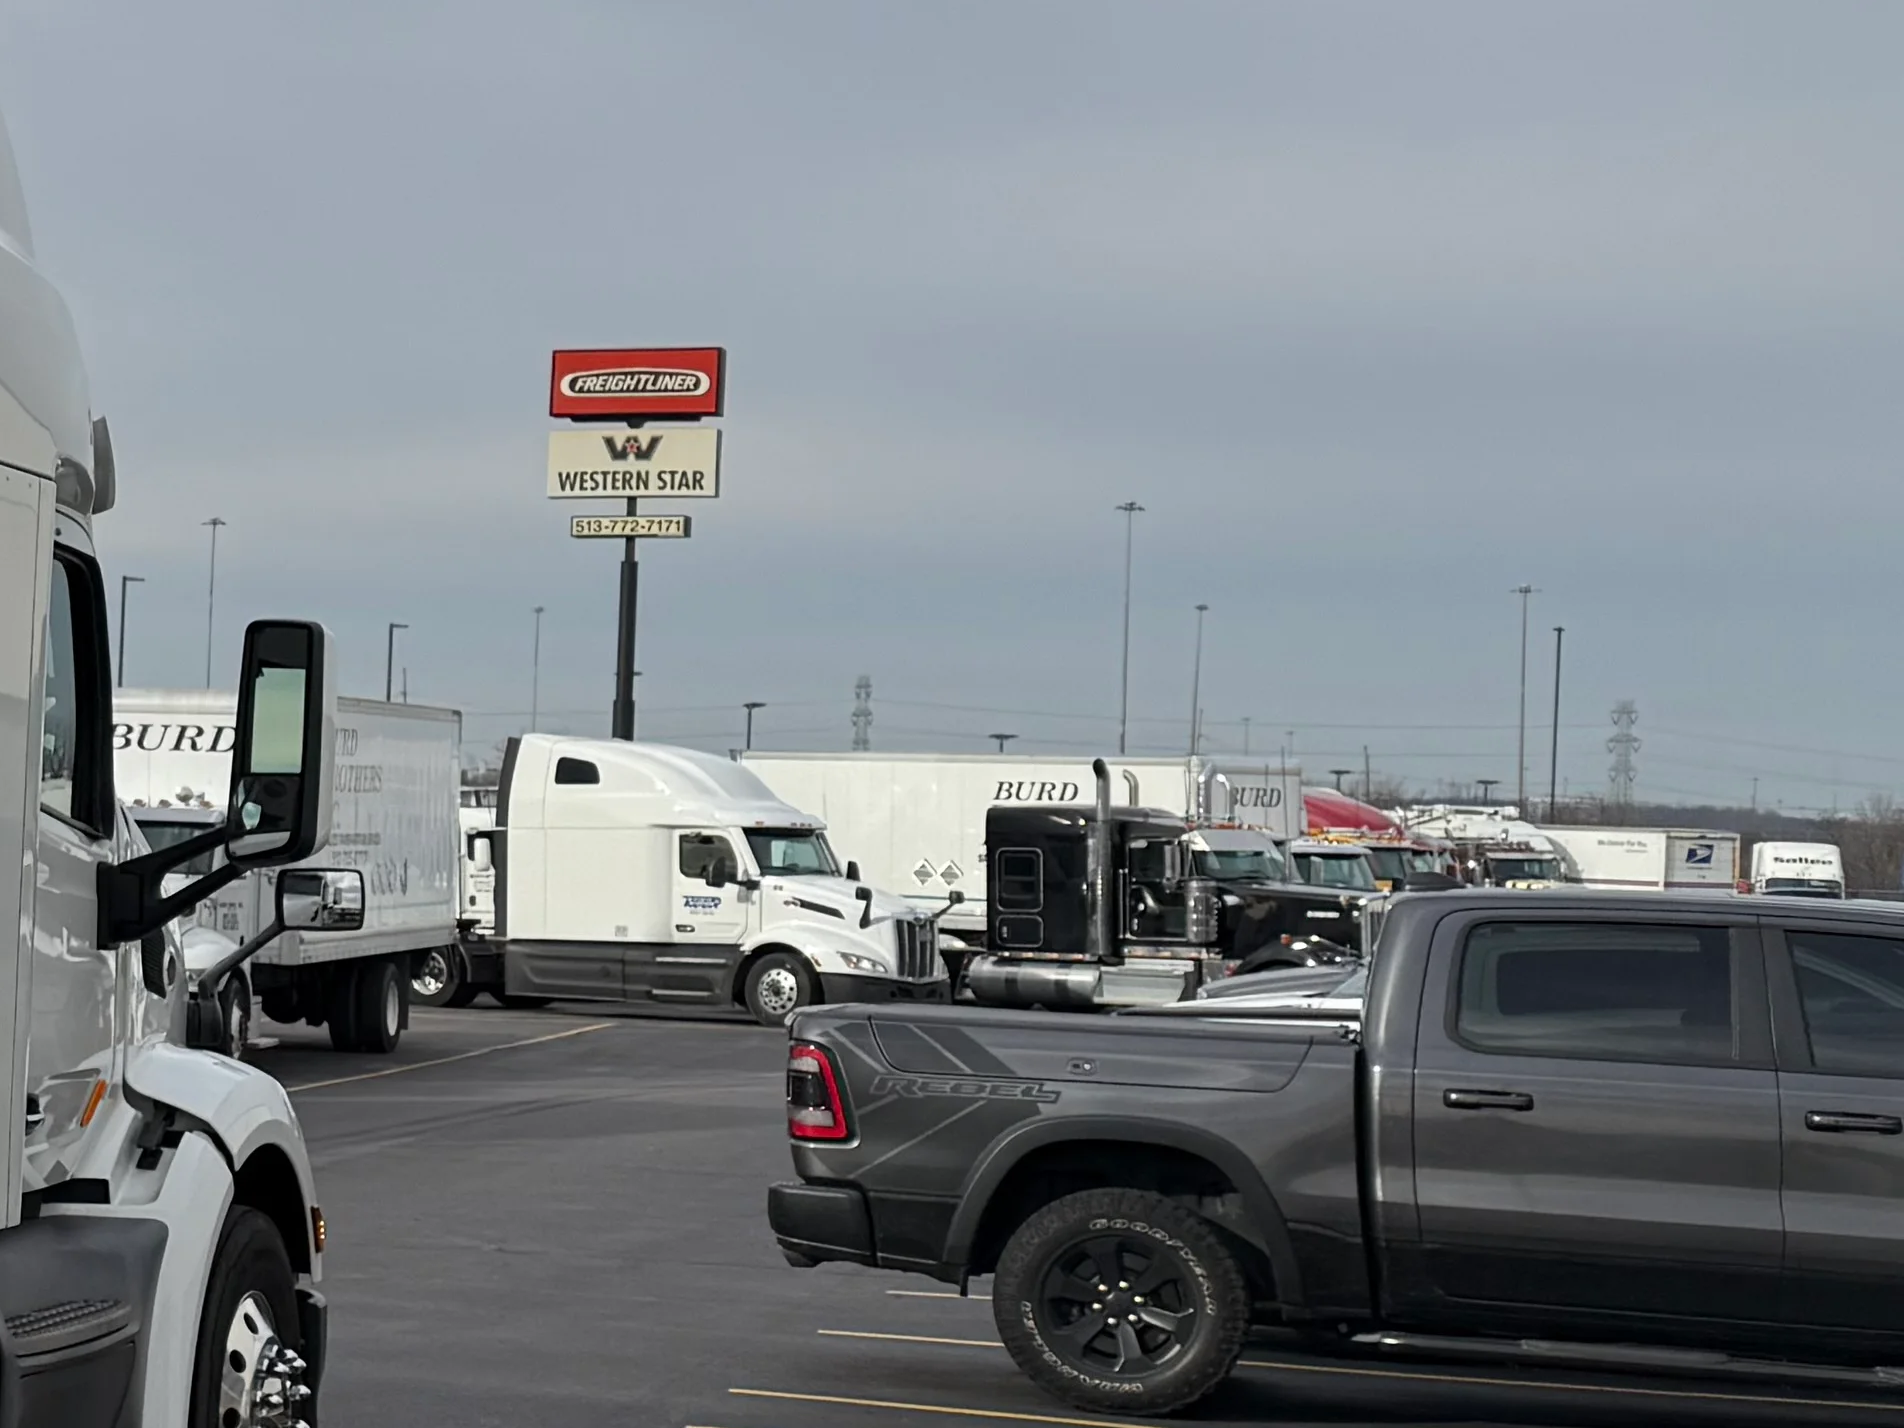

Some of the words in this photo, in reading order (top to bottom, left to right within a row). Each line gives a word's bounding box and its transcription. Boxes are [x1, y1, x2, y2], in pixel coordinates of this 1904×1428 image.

[574, 374, 697, 392] FREIGHTLINER
[558, 469, 650, 492] WESTERN
[656, 470, 705, 491] STAR
[574, 518, 682, 534] 513-772-7171
[112, 723, 236, 753] BURD
[992, 780, 1079, 802] BURD
[869, 1075, 1062, 1105] REBEL
